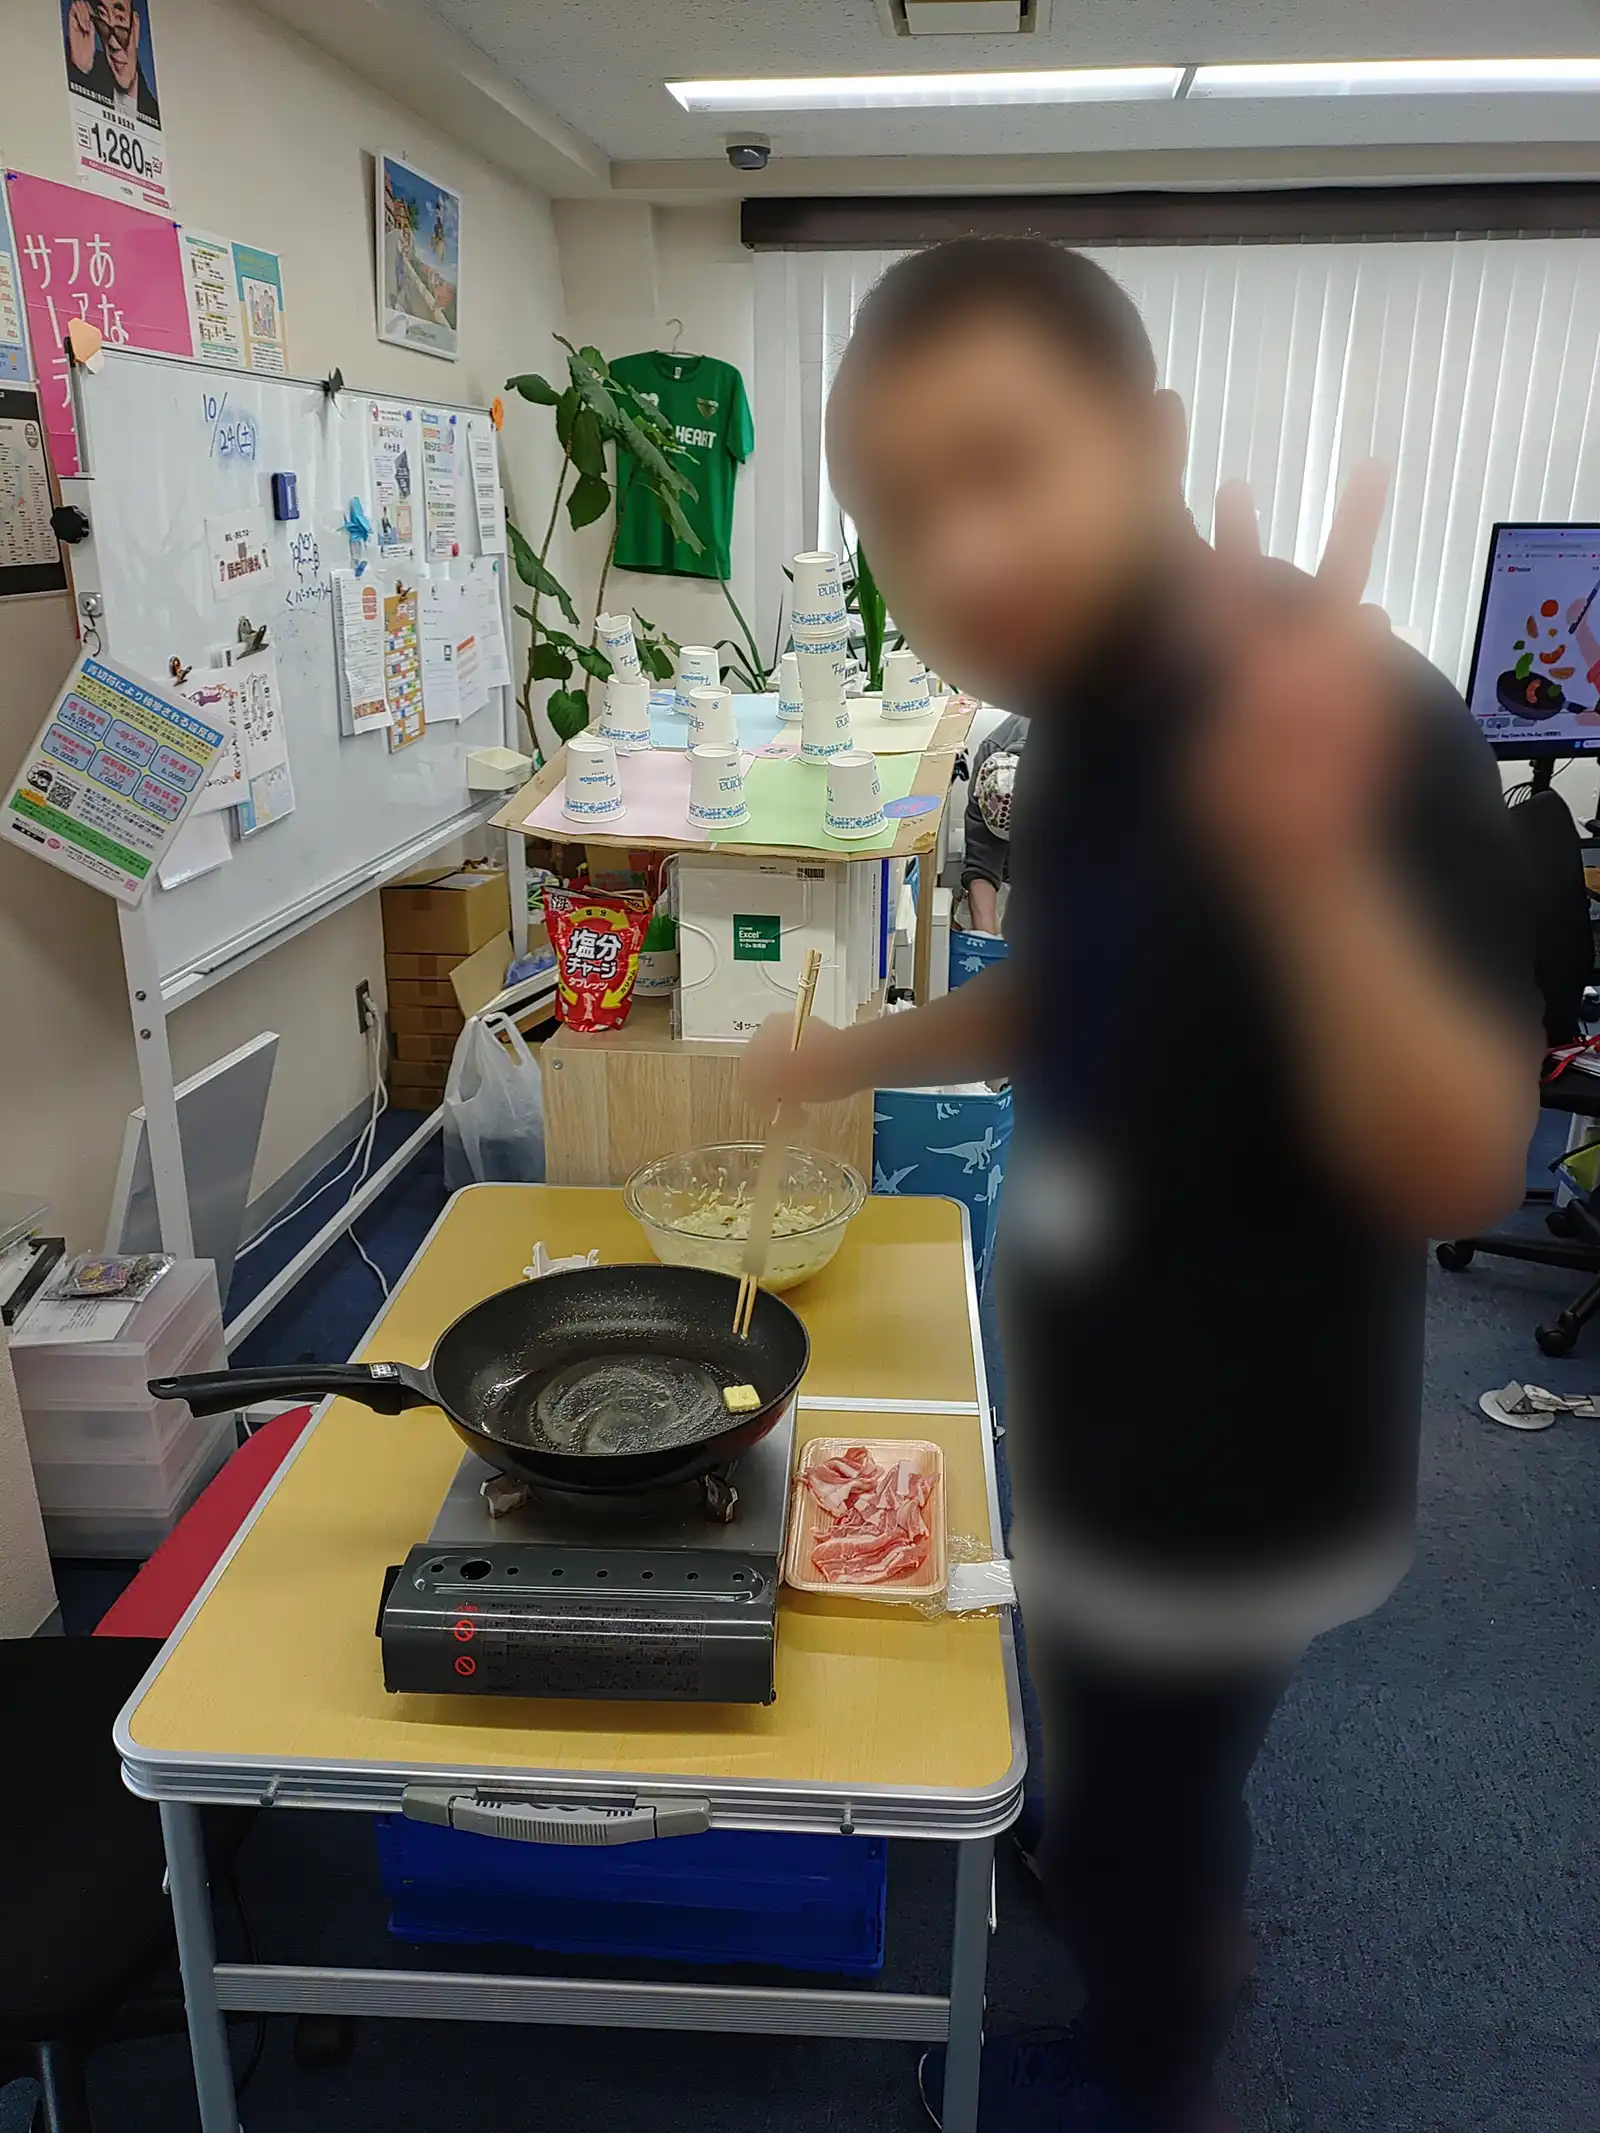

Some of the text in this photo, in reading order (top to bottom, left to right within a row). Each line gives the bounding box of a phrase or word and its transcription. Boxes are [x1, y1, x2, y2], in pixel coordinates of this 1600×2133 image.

[675, 426, 717, 449] HEART
[567, 928, 623, 962] 塩分
[566, 956, 618, 979] チャージ
